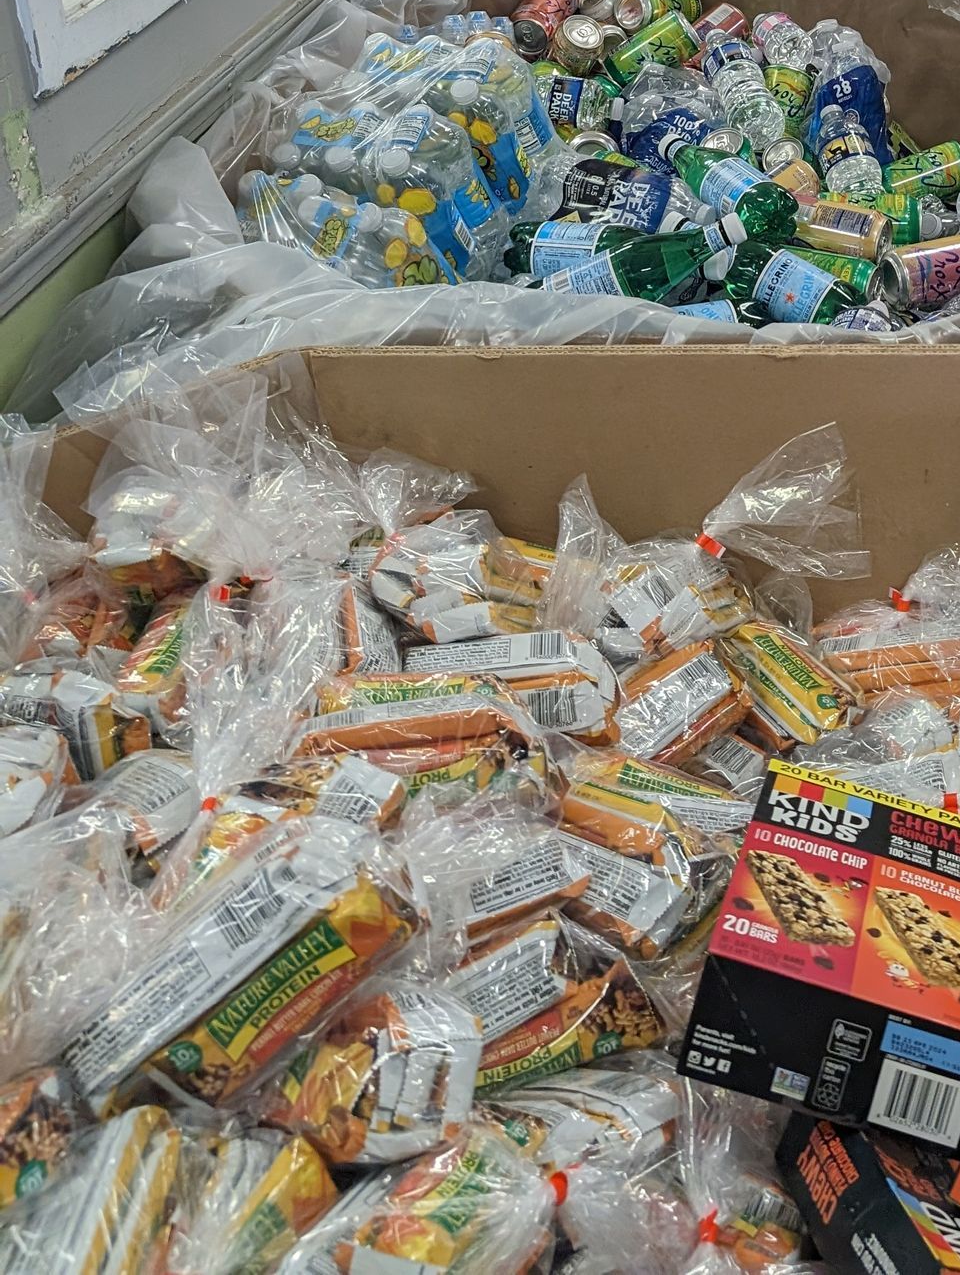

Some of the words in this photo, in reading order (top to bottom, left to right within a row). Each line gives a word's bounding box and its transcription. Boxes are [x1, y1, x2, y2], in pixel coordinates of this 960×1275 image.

[833, 80, 852, 99] 28
[550, 92, 563, 120] PARK
[559, 93, 573, 122] DEER
[410, 768, 450, 788] PROT
[780, 763, 802, 776] 20
[807, 771, 846, 790] BAR
[853, 785, 934, 815] VARIETY
[768, 789, 870, 830] KIND
[754, 828, 770, 842] 10
[890, 824, 948, 850] GRANOLA
[890, 835, 912, 848] 25%
[888, 847, 912, 861] 100%
[937, 857, 947, 866] NO
[881, 864, 897, 879] 10
[900, 870, 948, 889] PEANUT
[722, 914, 750, 936] 20
[749, 927, 778, 944] BARS
[210, 975, 277, 1042] NATURE
[271, 924, 334, 980] VALLEY
[250, 964, 321, 1029] PROTEIN
[484, 1046, 553, 1084] PROTEIN
